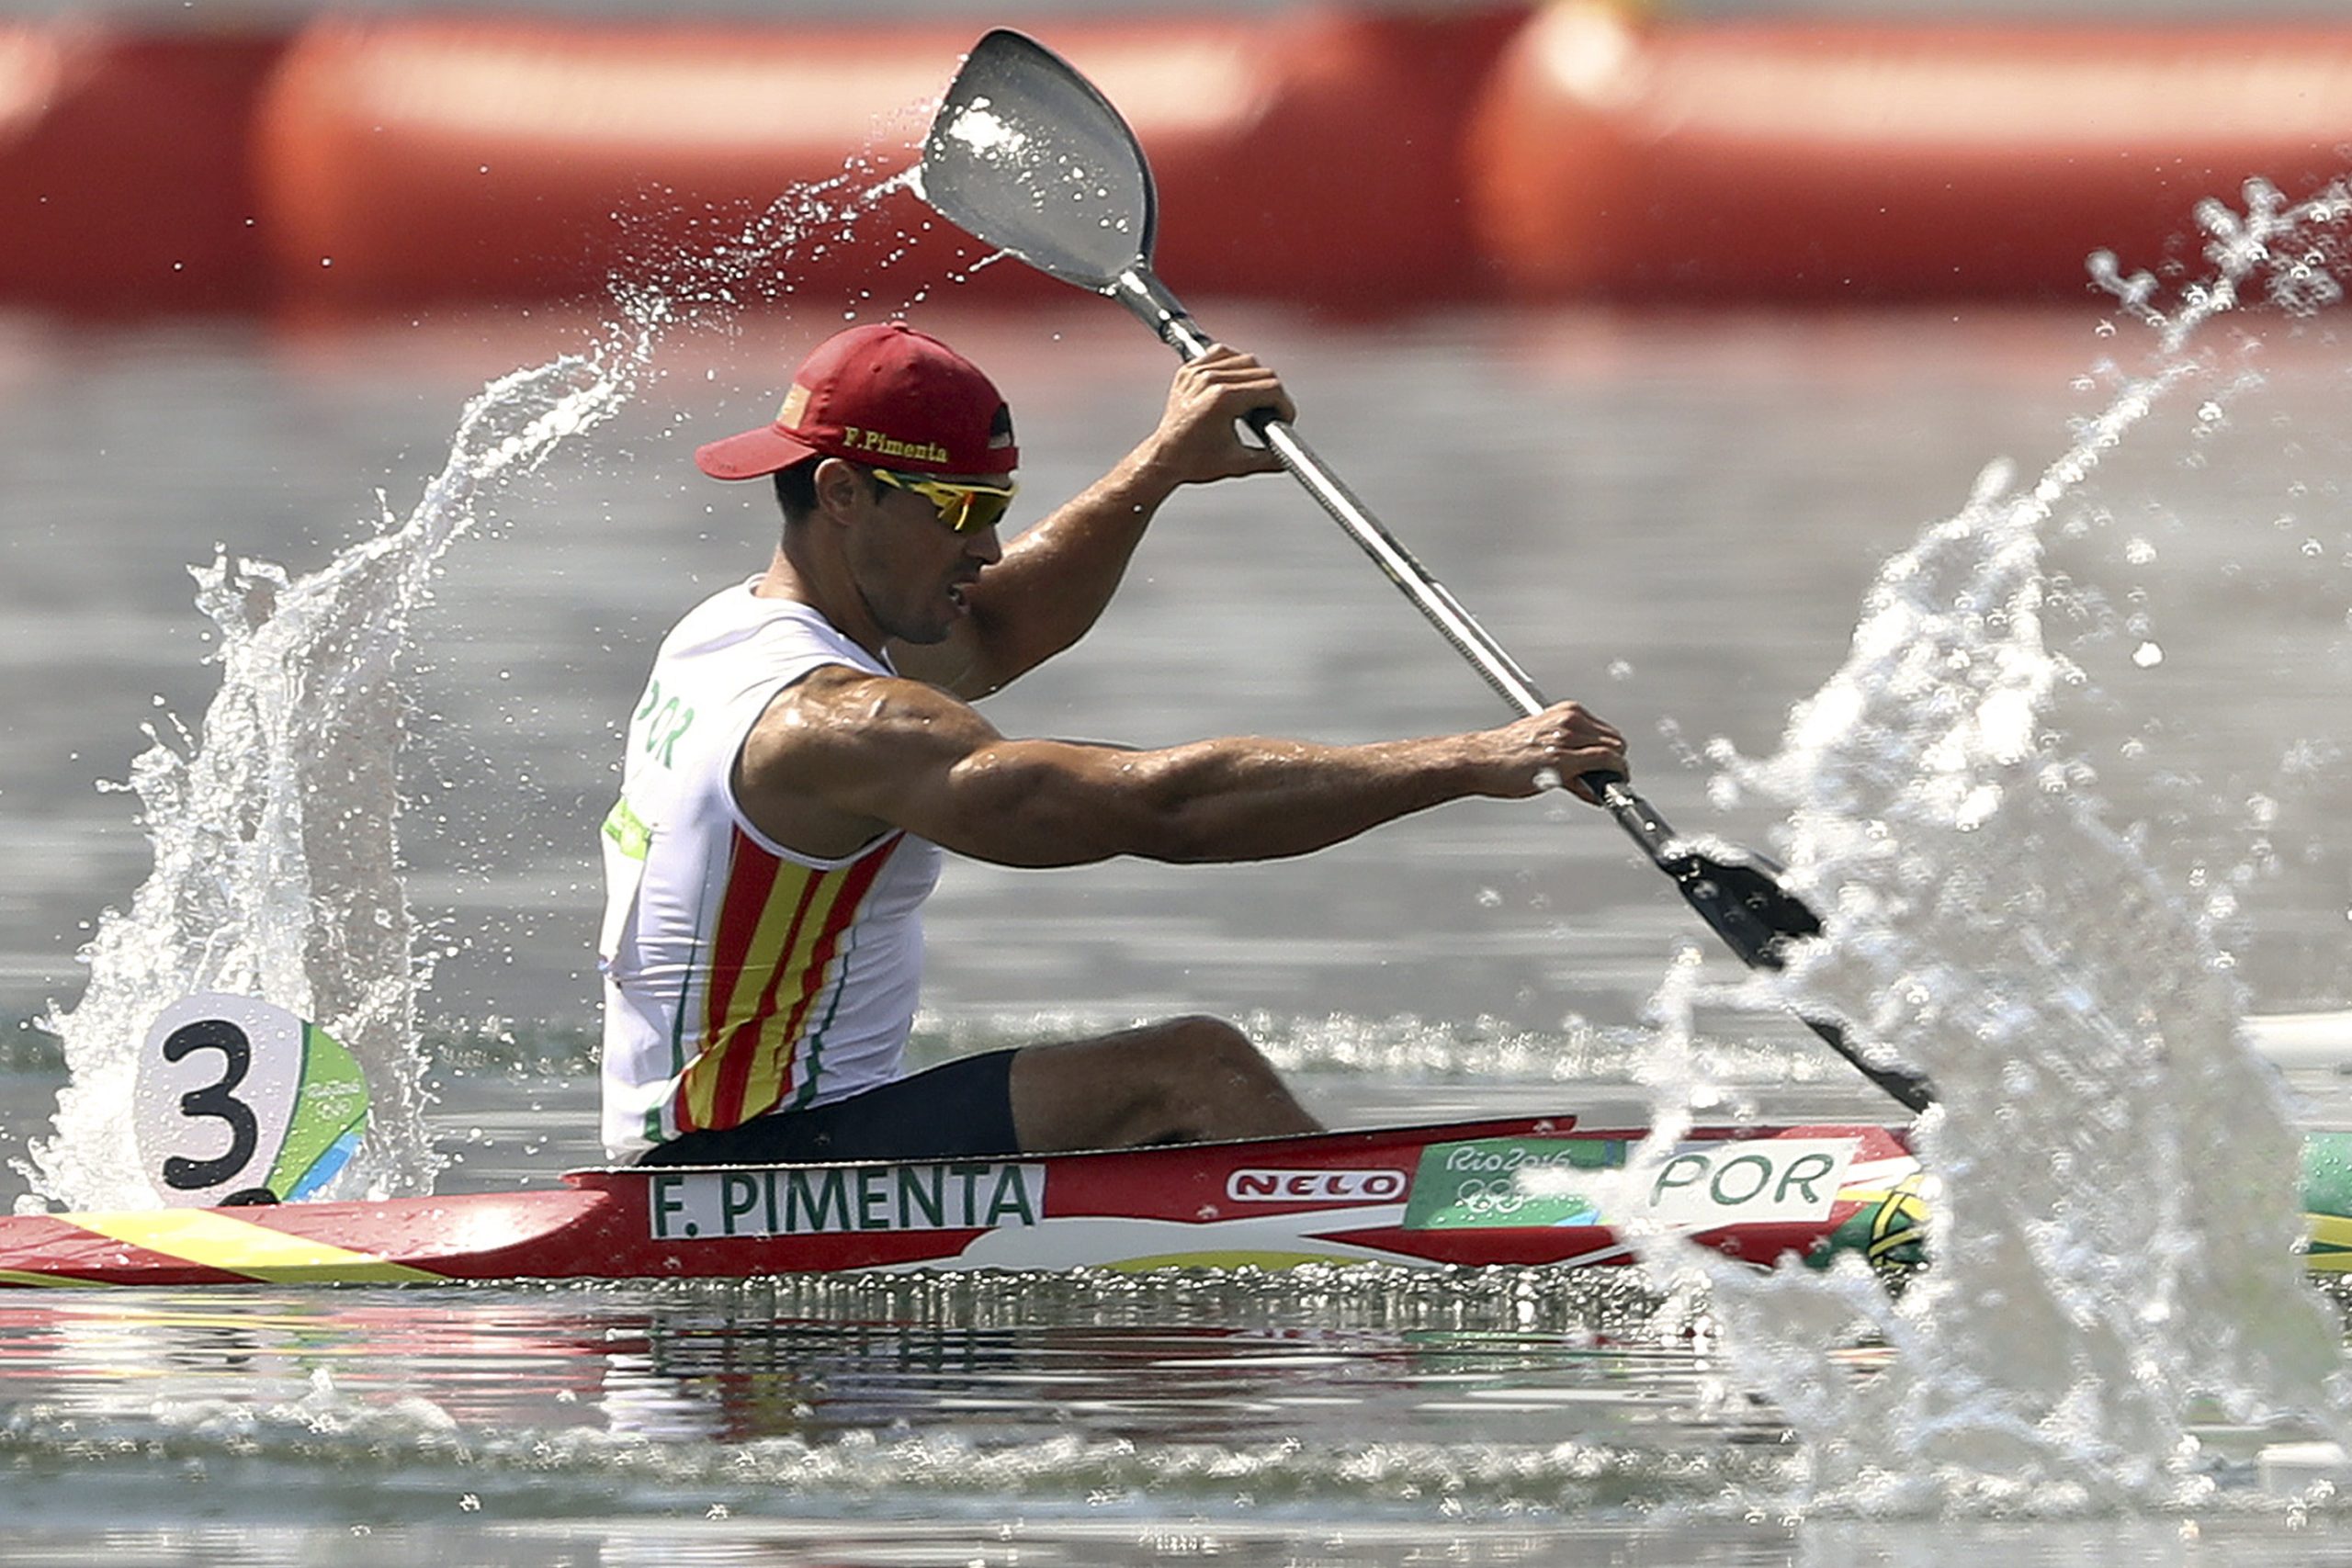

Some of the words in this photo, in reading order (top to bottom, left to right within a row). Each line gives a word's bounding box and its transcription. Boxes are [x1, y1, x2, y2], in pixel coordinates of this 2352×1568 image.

[843, 426, 948, 463] F.Pimenta
[163, 1020, 257, 1189] 3
[653, 1176, 699, 1237] F.
[721, 1164, 1033, 1235] PIMENTA
[1236, 1175, 1401, 1195] NELO
[1650, 1154, 1834, 1206] POR
